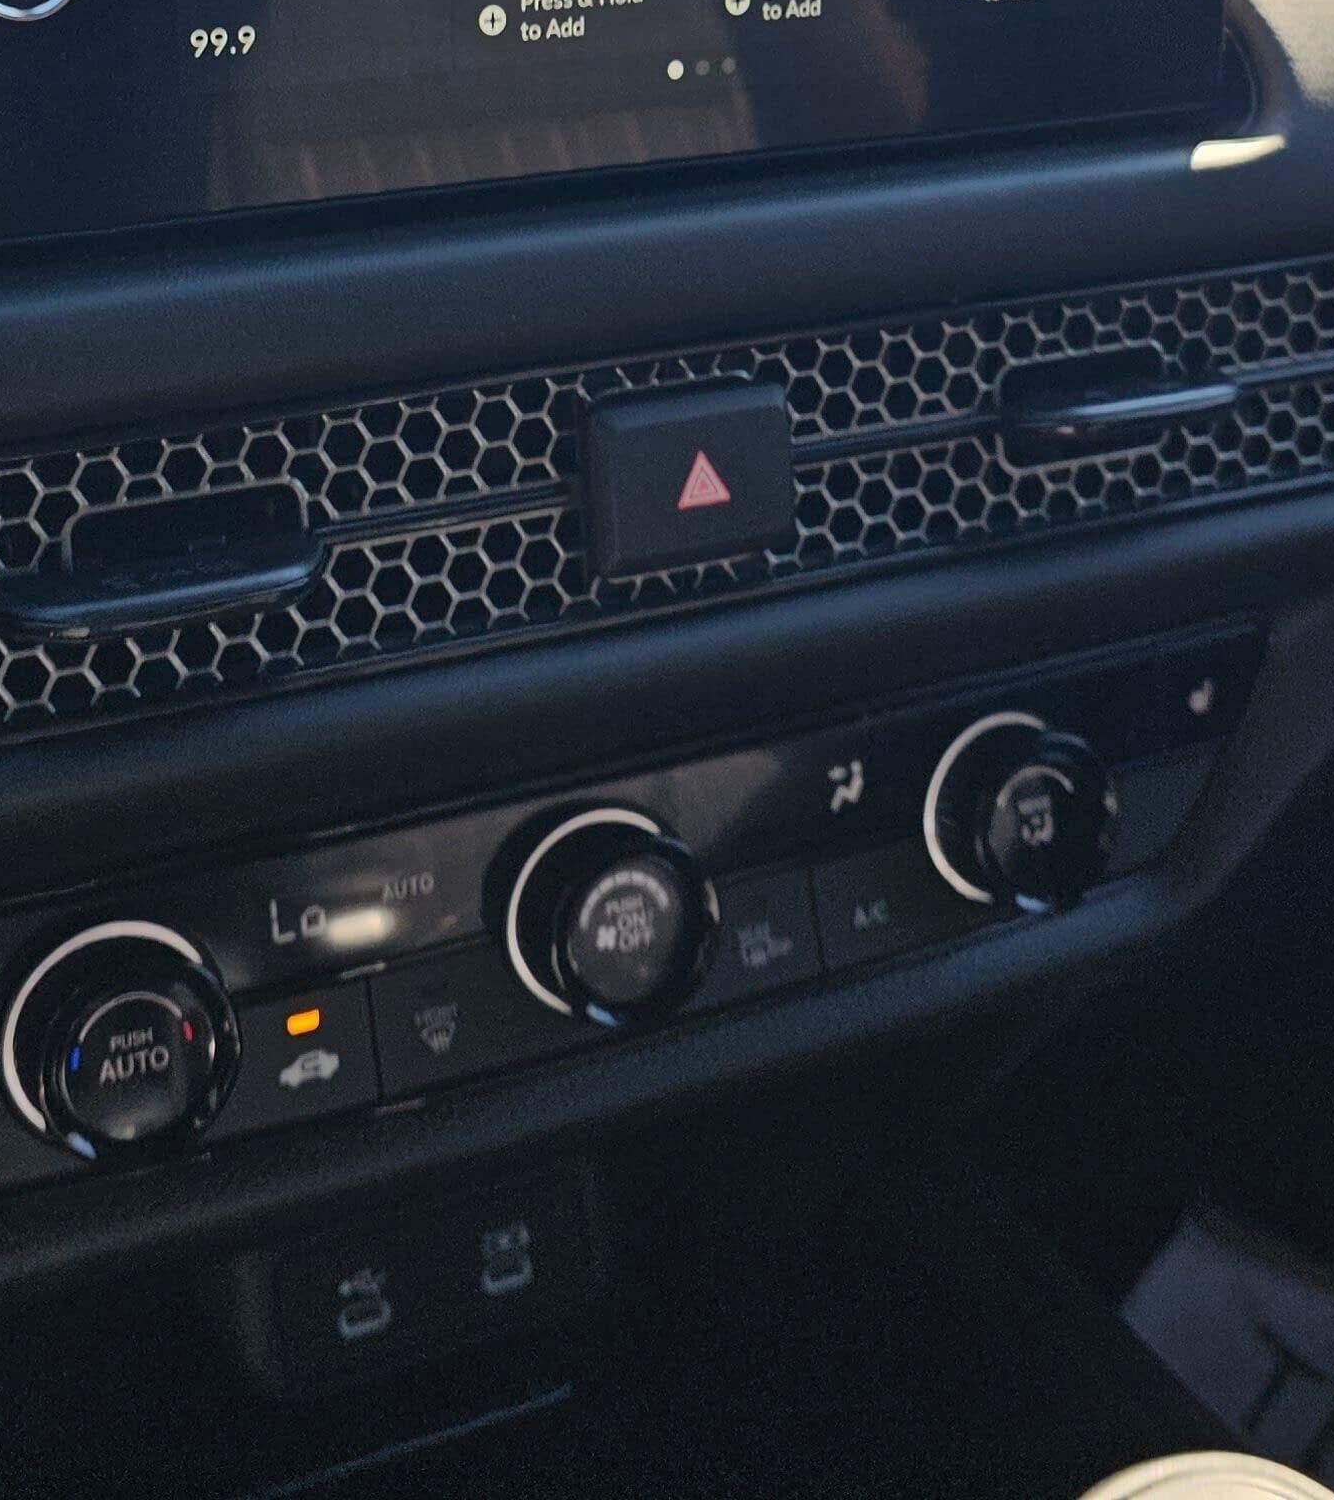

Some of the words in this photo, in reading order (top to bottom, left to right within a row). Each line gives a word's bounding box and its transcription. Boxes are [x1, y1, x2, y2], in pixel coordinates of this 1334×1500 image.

[763, 2, 782, 20] to
[190, 24, 256, 58] 99.9
[520, 21, 542, 41] to
[546, 15, 585, 40] Add
[383, 872, 435, 901] AUTO
[99, 1046, 169, 1086] AUTO
